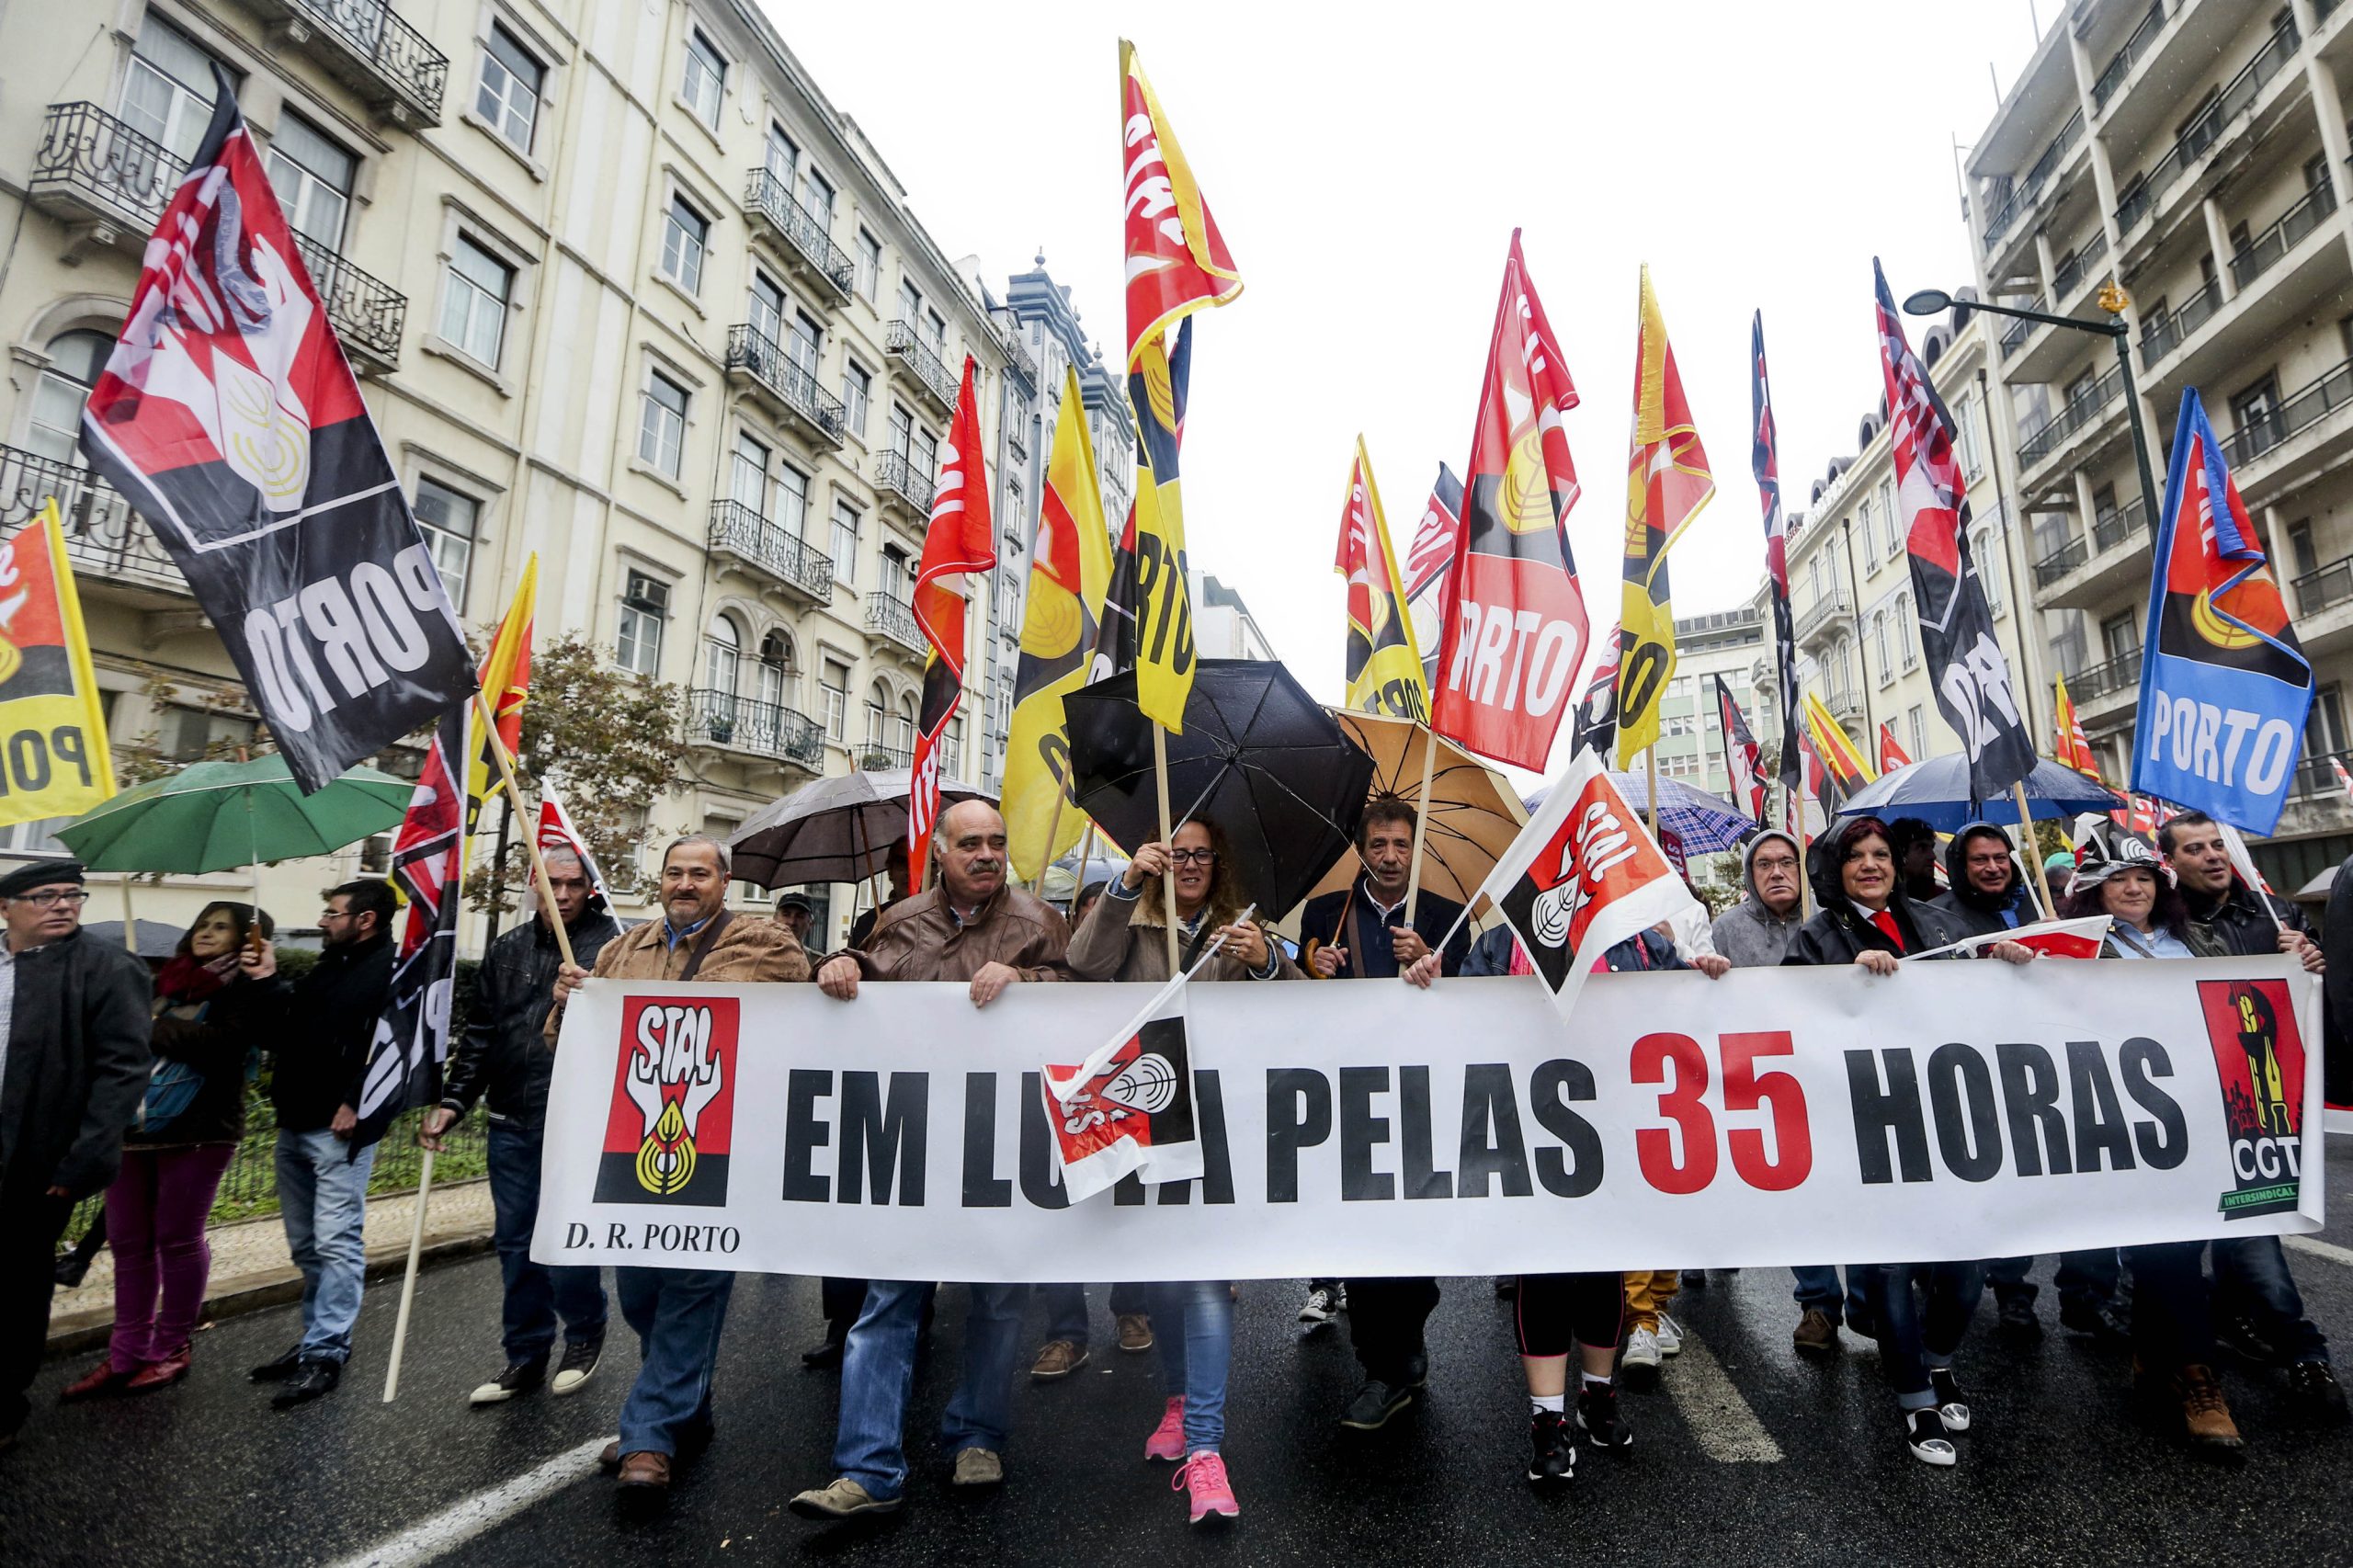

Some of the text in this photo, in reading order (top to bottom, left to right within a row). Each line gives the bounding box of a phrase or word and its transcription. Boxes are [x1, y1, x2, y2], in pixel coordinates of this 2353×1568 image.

[2150, 689, 2294, 796] PORTO
[1575, 801, 1638, 883] STAL
[636, 1004, 713, 1085] STAL
[782, 1030, 2189, 1210] EM LUA PELAS 35 HORAS
[2233, 1136, 2300, 1181] CGT
[2224, 1187, 2297, 1207] INTERSINDICAL
[563, 1221, 741, 1255] D. R. PORTO
